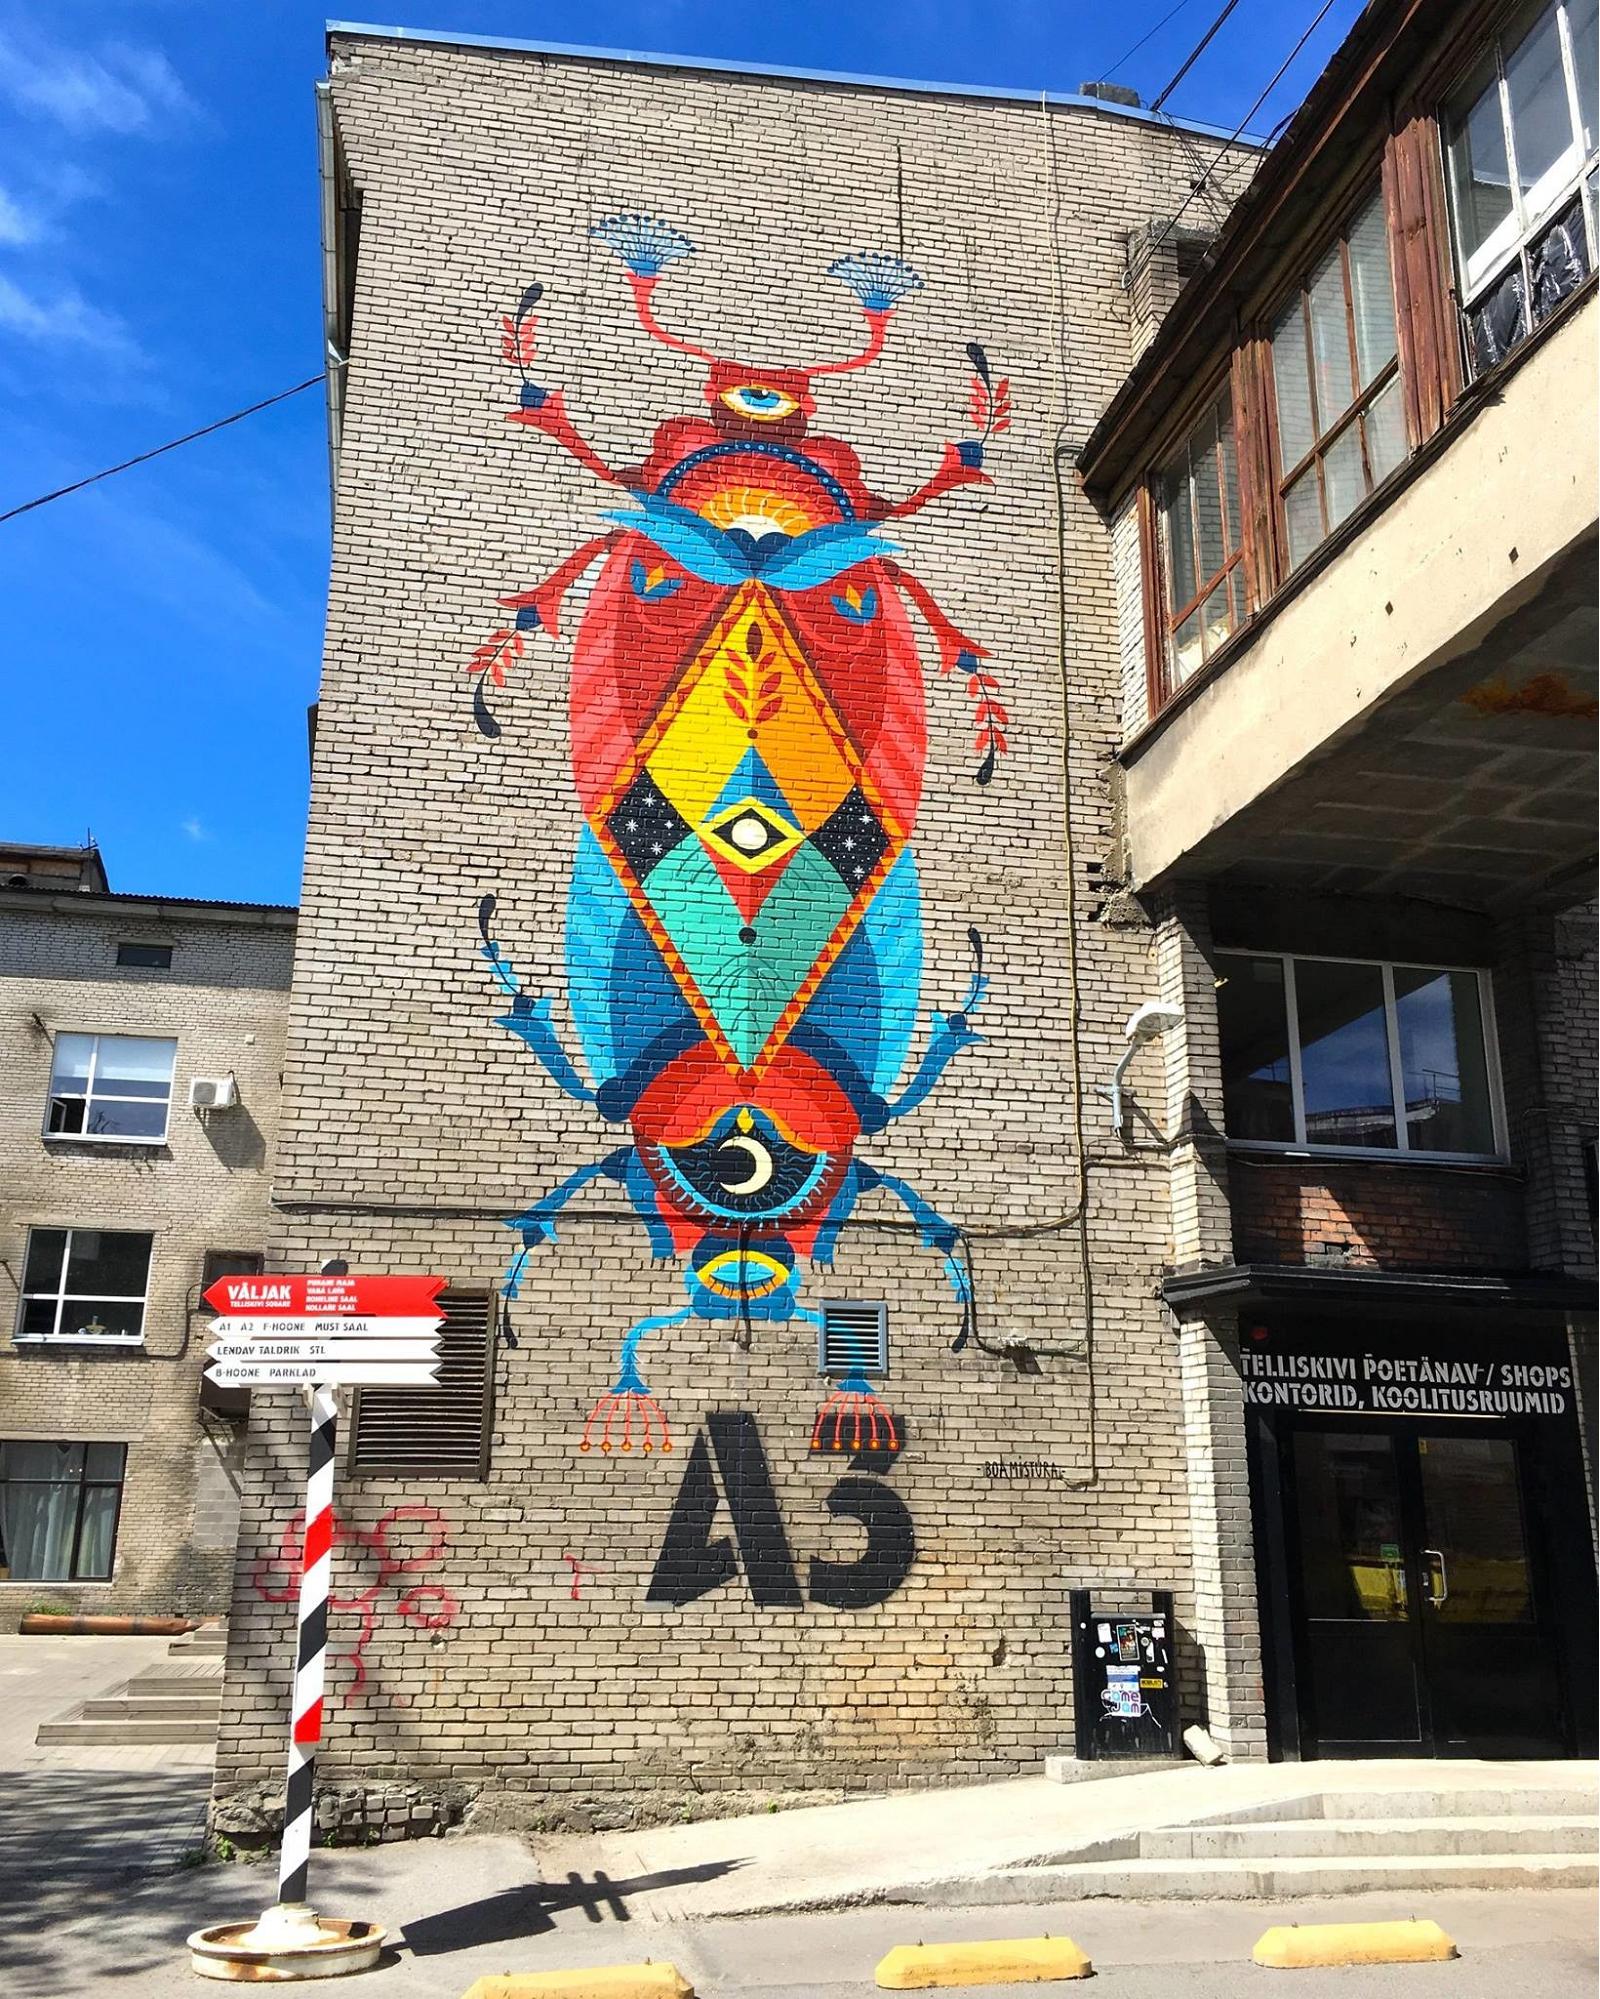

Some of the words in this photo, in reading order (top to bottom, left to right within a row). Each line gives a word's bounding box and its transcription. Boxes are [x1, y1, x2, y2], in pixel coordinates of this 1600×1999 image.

[219, 1322, 231, 1331] A1
[240, 1322, 254, 1331] A2
[315, 1322, 339, 1331] MUST
[343, 1322, 368, 1331] SAAL
[217, 1346, 255, 1355] LENDAV
[259, 1346, 300, 1354] TALDRIK
[1239, 1354, 1357, 1380] TELLISKIVI
[1500, 1365, 1572, 1388] SHOPS
[1242, 1381, 1364, 1409] KONTORID,
[1371, 1386, 1566, 1414] KOOLITUSRUUMID
